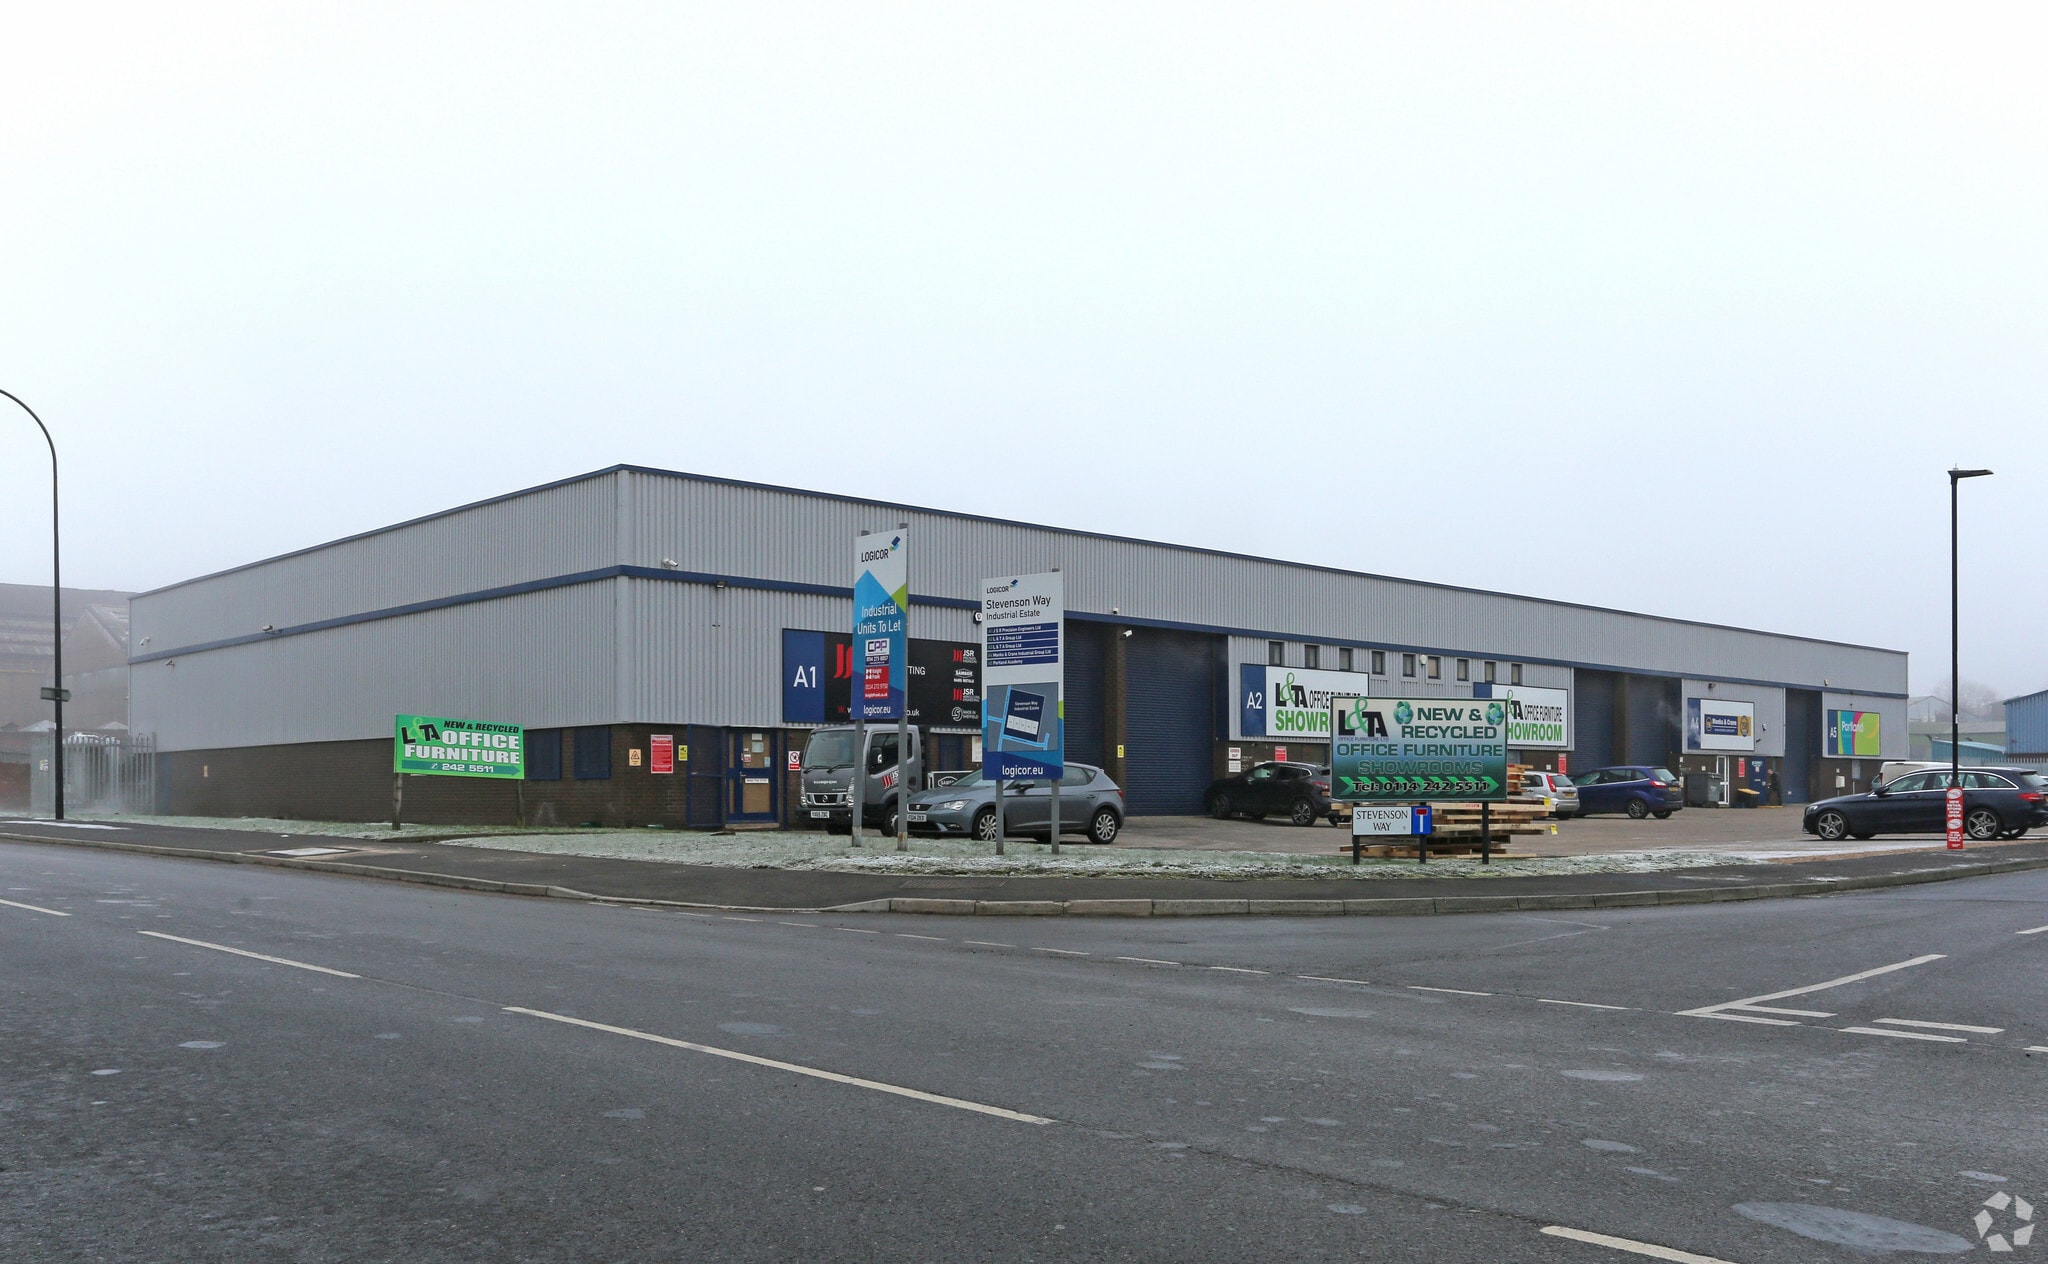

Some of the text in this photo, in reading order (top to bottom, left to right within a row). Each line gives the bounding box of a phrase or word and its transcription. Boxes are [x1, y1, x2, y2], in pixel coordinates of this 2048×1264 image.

[862, 549, 888, 562] LOGICOR
[987, 586, 1009, 594] LOGICOR
[986, 595, 1051, 609] Stevenson Way
[862, 603, 897, 618] Industrial
[987, 612, 1018, 620] Industrial
[858, 620, 901, 634] Units To Let
[793, 665, 816, 688] A1
[907, 665, 926, 676] TING
[1246, 691, 1262, 709] A2
[1310, 690, 1329, 709] OFFICE
[1507, 689, 1562, 722] &TA OFFICE FURNITURE
[864, 705, 891, 716] logicor.eu
[1417, 708, 1482, 721] NEW &
[444, 720, 465, 729] NEW
[475, 723, 519, 733] RECYCLED
[1275, 710, 1329, 732] SHOWR
[1690, 717, 1699, 730] A4
[1842, 721, 1864, 732] Portland
[1401, 726, 1497, 739] RECYCLED
[1507, 722, 1562, 741] HOWROOM
[1830, 727, 1837, 738] A5
[442, 730, 520, 749] OFFICE
[404, 744, 520, 764] FURNITURE
[1337, 744, 1503, 757] OFFICE FURNITURE
[442, 763, 494, 773] 242 5511
[1002, 765, 1043, 777] logicor.eu
[1358, 760, 1483, 774] SHOWROOMS
[1353, 781, 1488, 792] Tel: 0114 242 5511
[1356, 810, 1408, 820] STEVENSON
[1373, 823, 1391, 831] WAY
